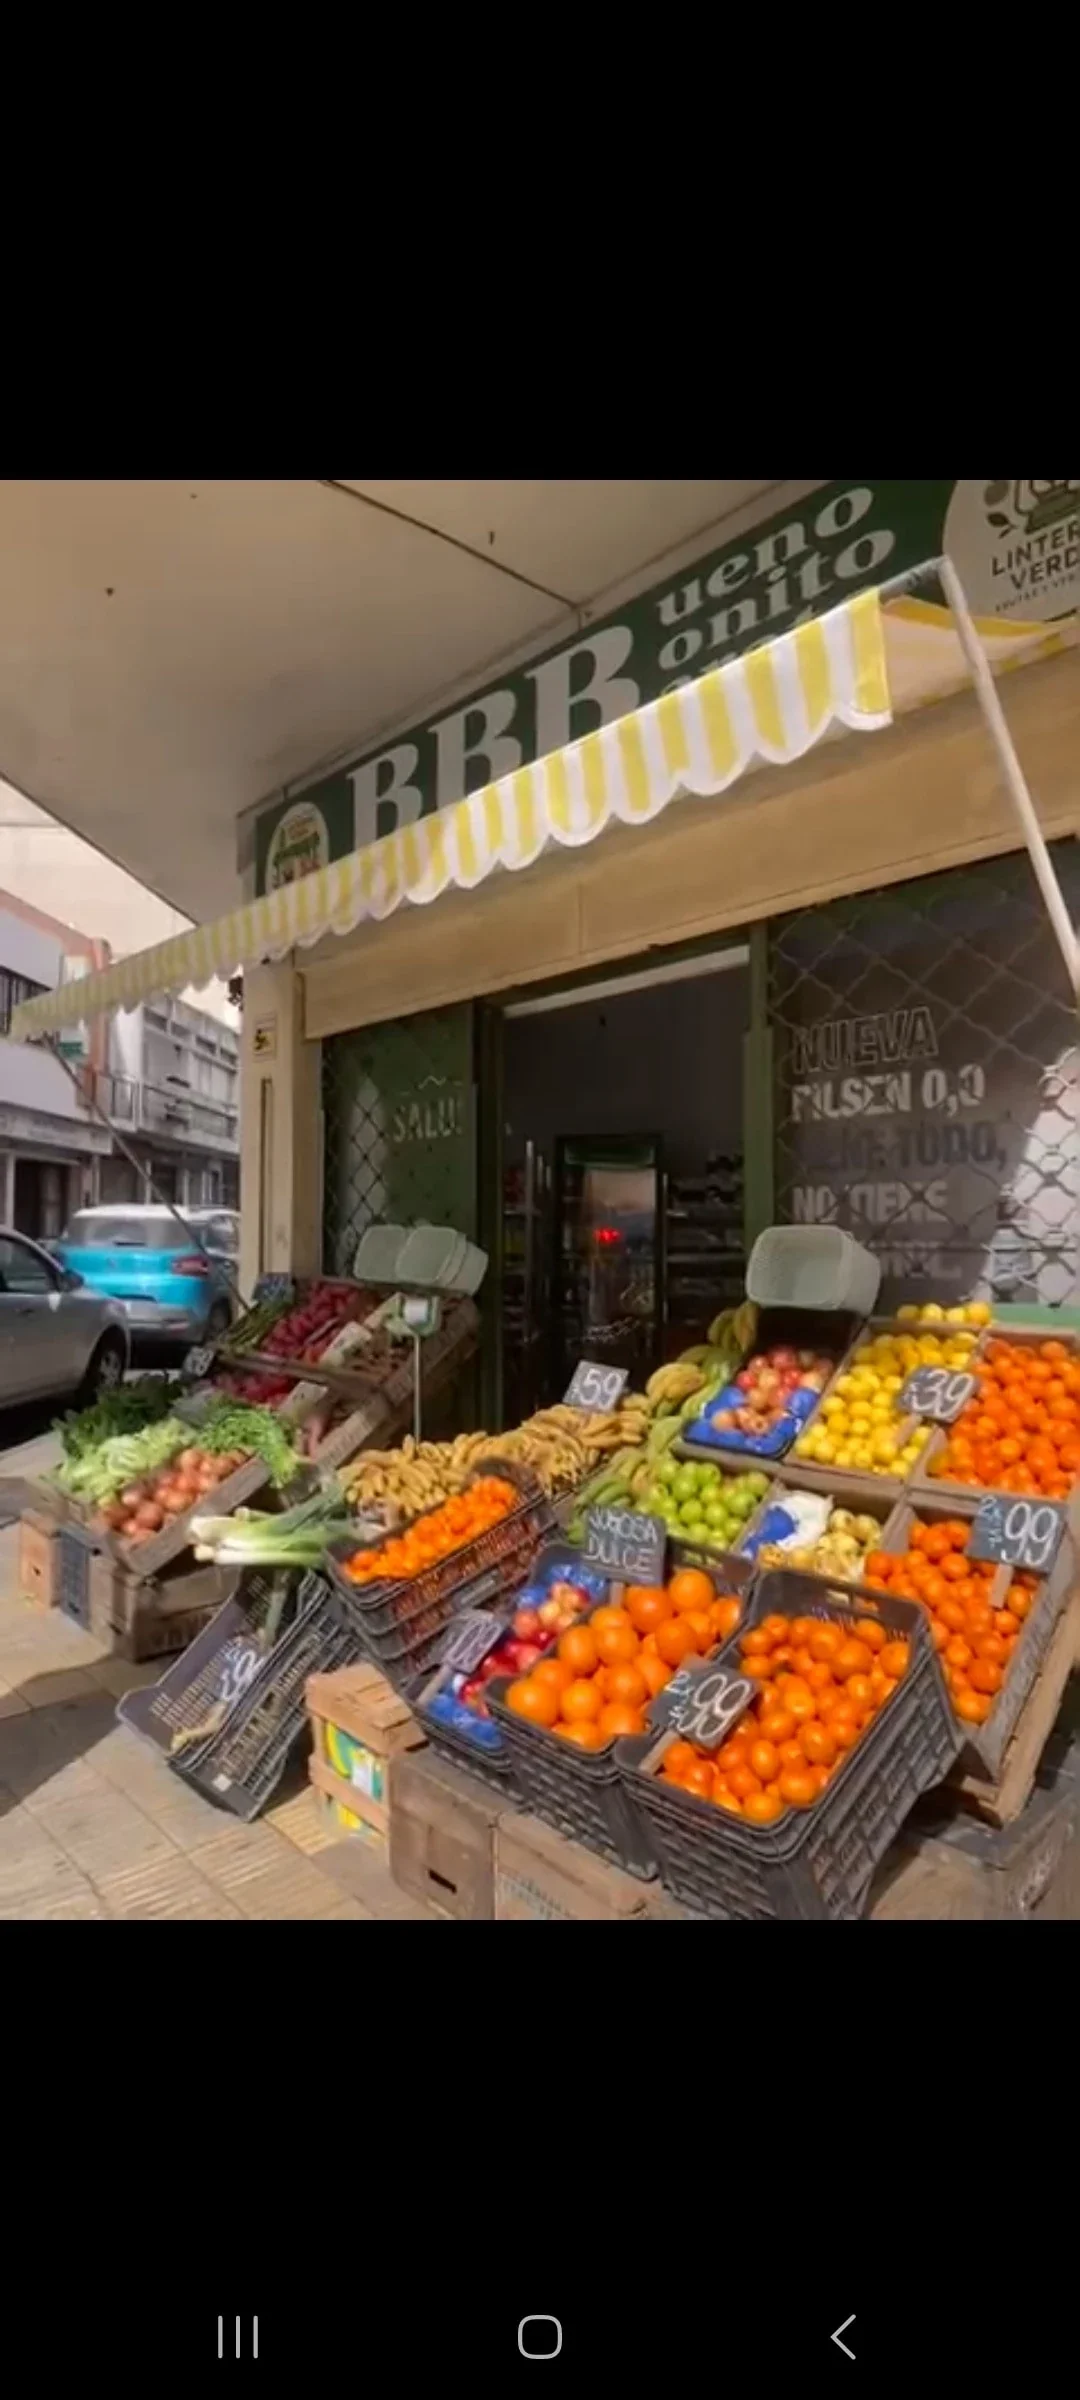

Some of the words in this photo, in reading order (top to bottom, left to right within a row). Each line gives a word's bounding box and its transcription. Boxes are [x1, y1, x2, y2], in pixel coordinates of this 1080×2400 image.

[656, 488, 874, 627] ueno
[658, 529, 896, 671] onito
[346, 625, 641, 853] BBB
[792, 1004, 940, 1076] NUEVA
